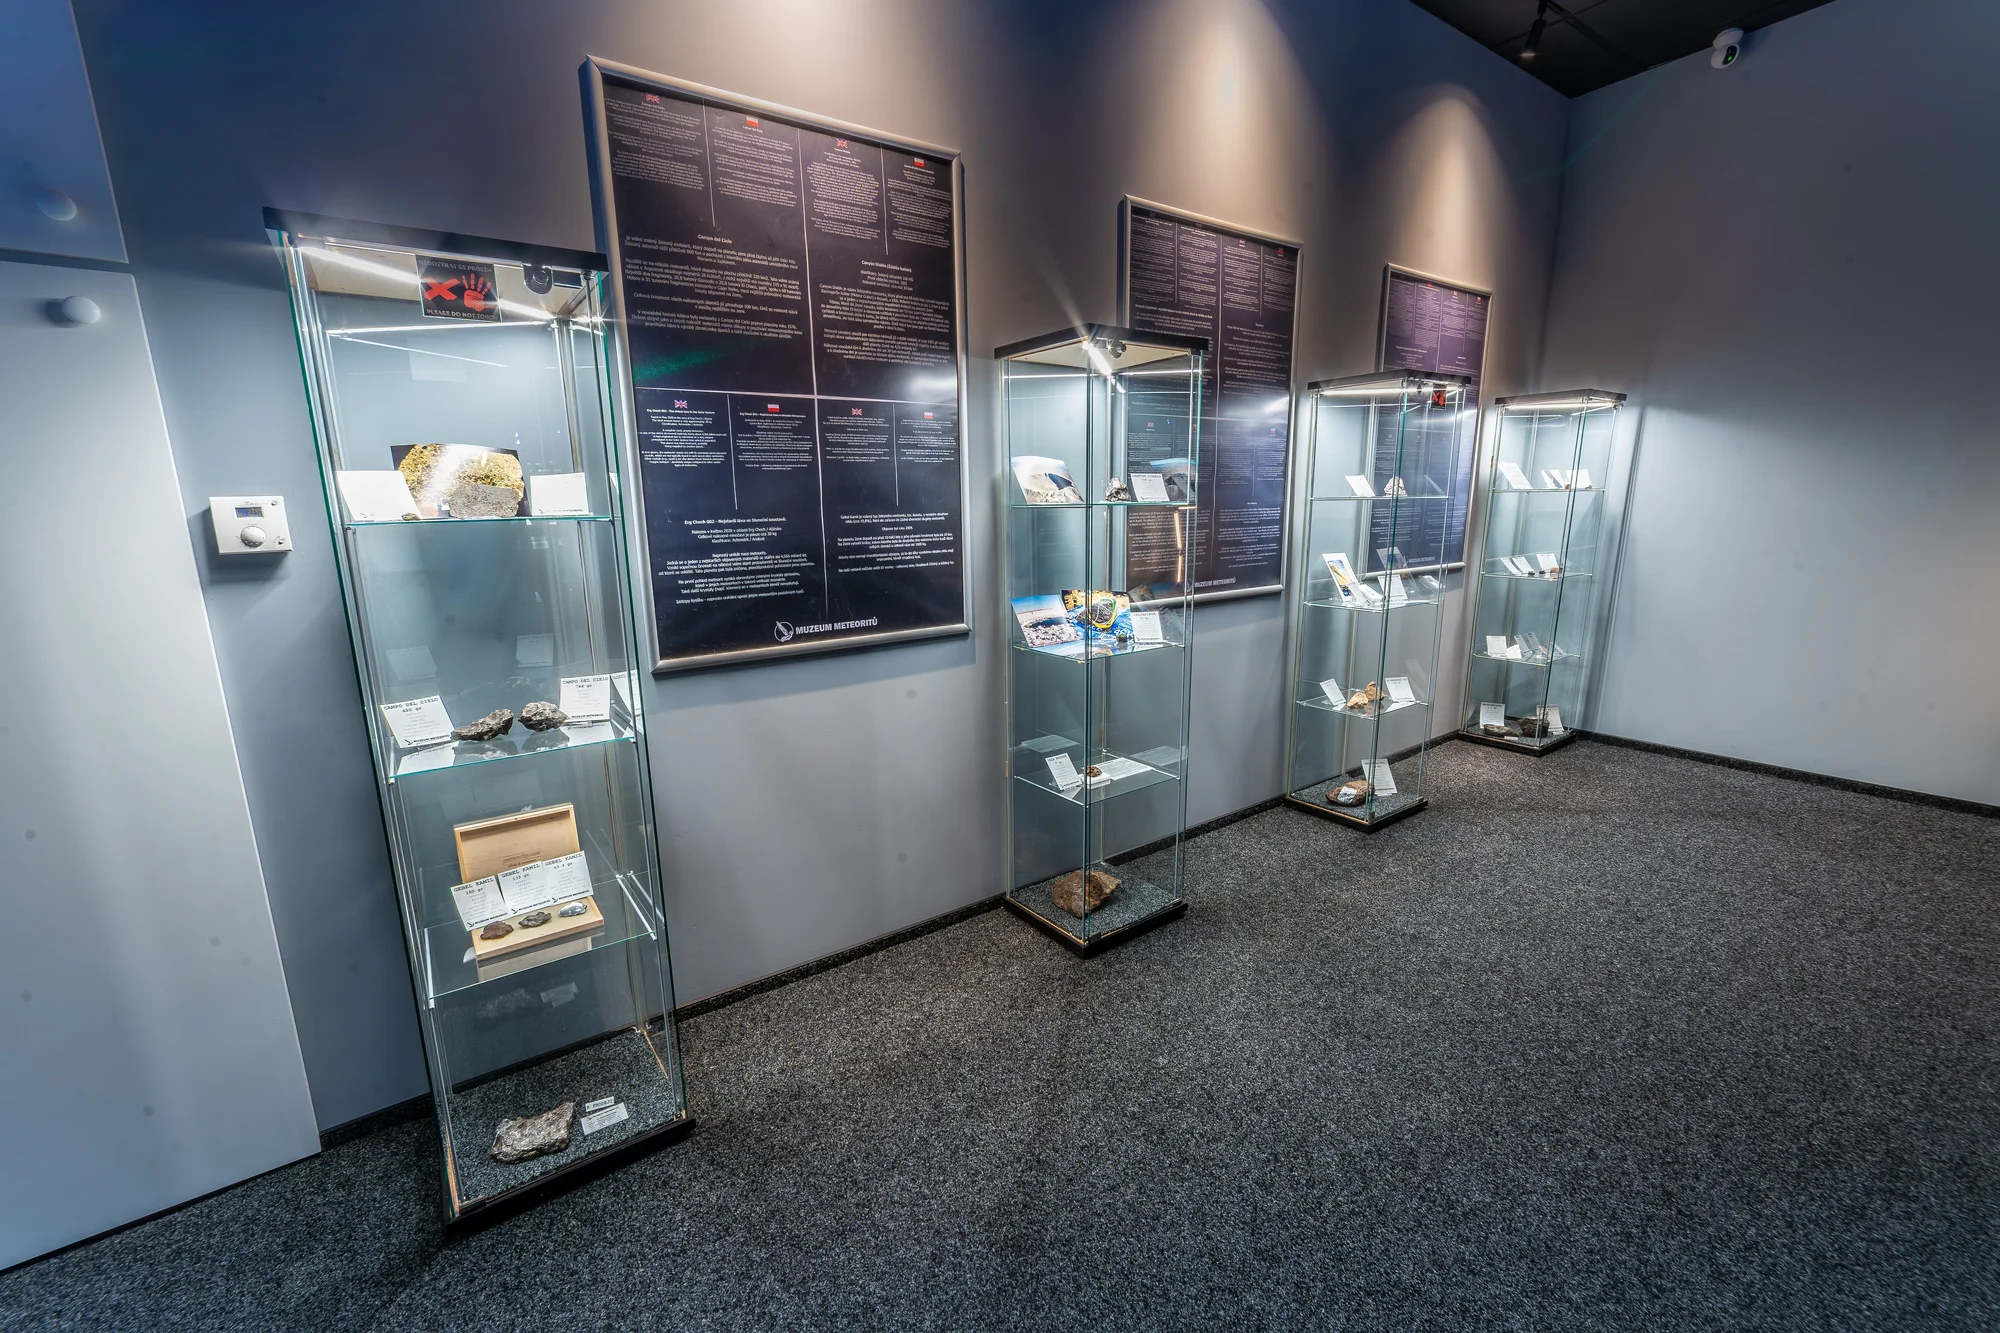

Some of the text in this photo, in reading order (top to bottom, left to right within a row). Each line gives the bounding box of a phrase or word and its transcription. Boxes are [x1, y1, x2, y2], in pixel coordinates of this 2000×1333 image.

[796, 616, 878, 635] MUZEUM METEORITŮ
[545, 853, 582, 866] GEBEL KAMIL
[501, 863, 540, 878] GEBEL KAMIL
[454, 878, 494, 893] GEBEL KAMIL
